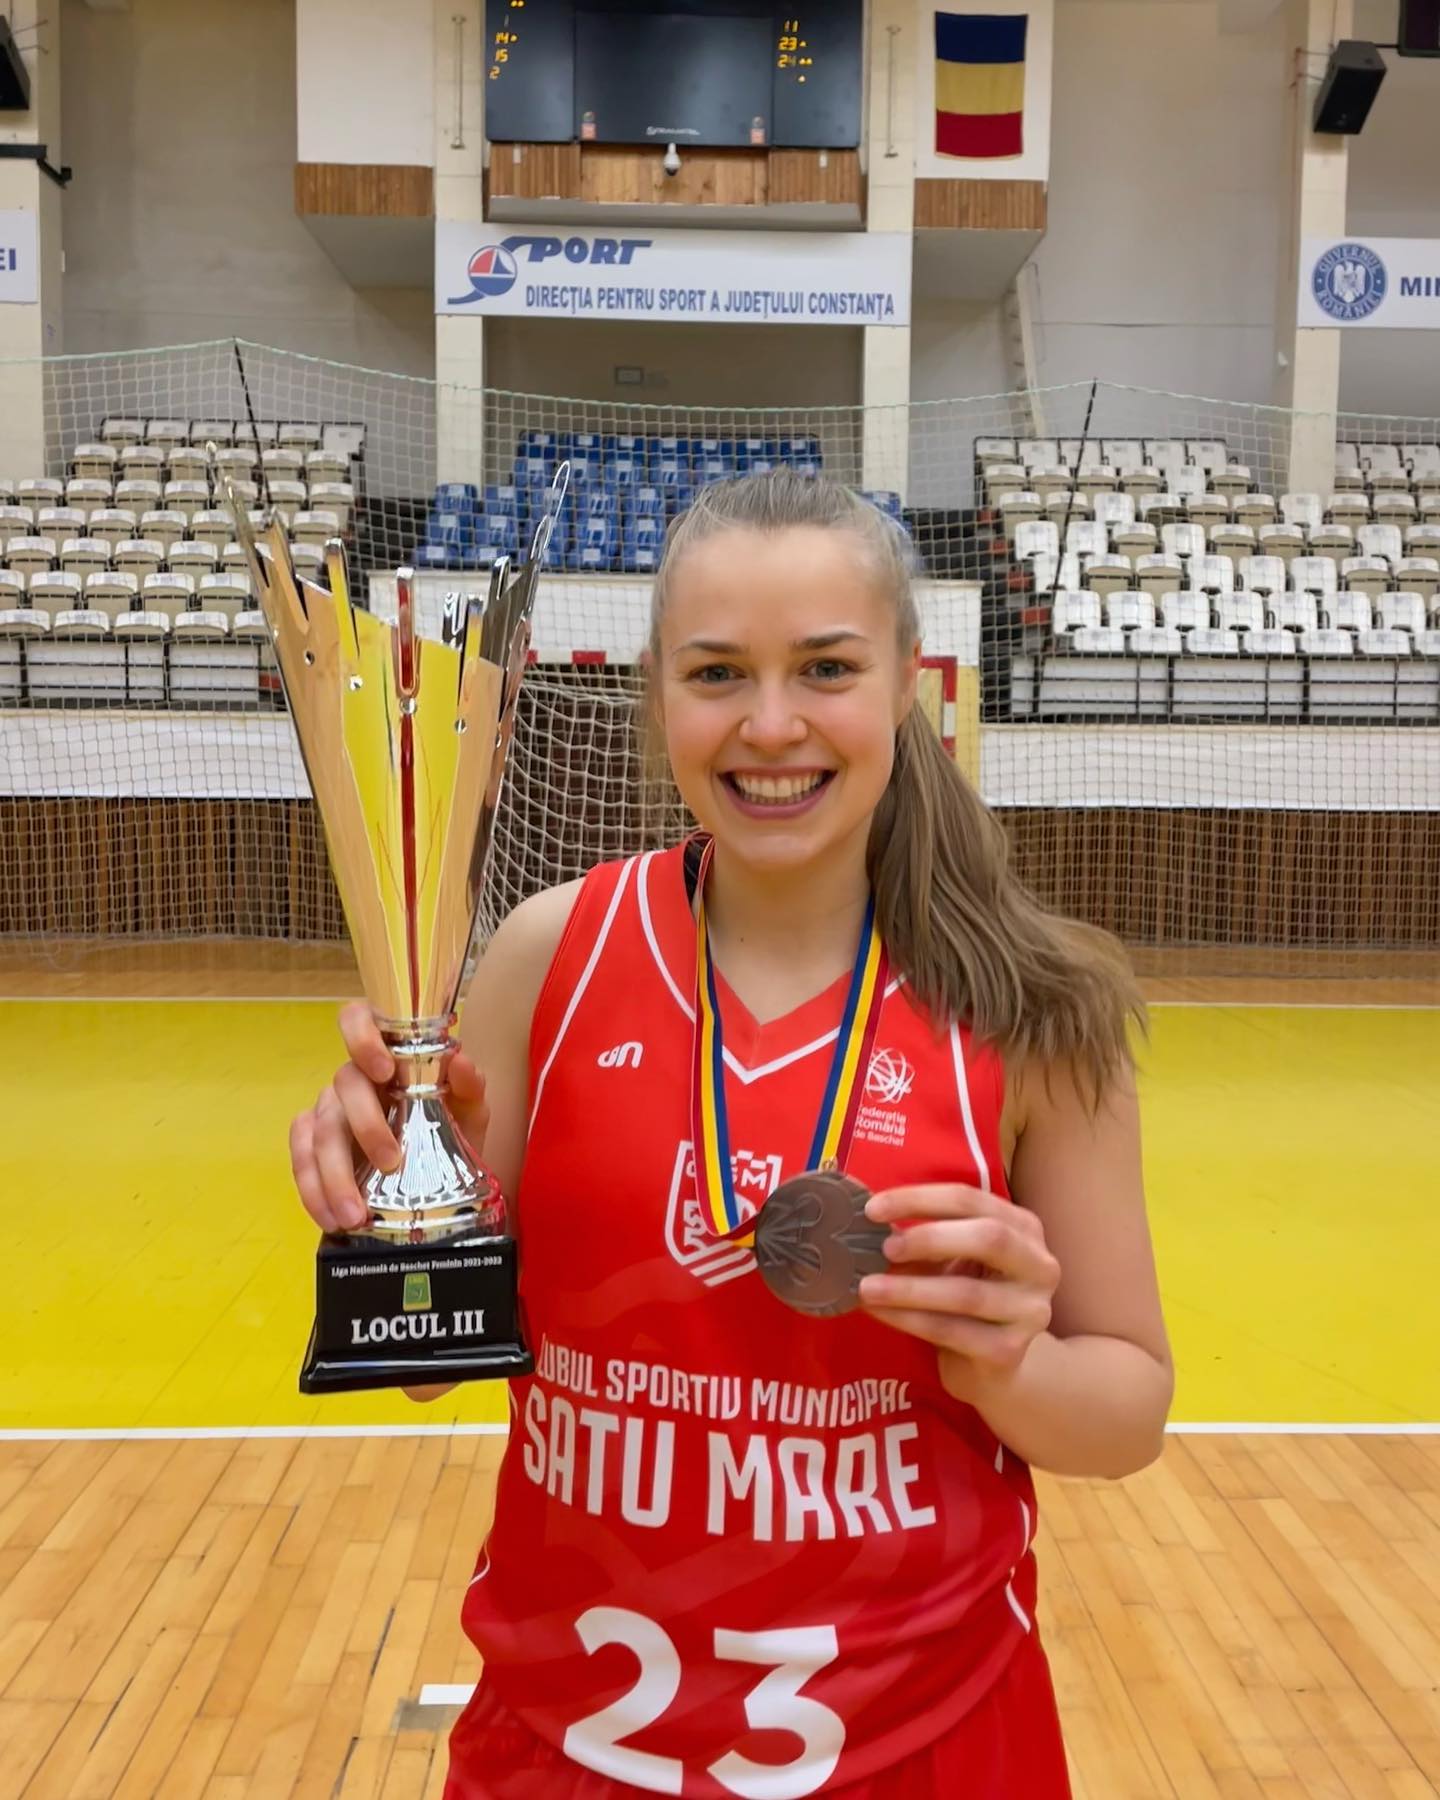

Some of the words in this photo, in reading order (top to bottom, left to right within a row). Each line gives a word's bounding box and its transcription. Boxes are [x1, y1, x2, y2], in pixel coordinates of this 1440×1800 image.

[779, 36, 798, 51] 23
[597, 287, 655, 310] PENTRU
[659, 288, 706, 312] SPORT
[710, 290, 721, 312] A
[331, 1265, 348, 1279] Liga
[388, 1261, 399, 1273] de
[400, 1260, 430, 1273] Baschet
[431, 1258, 463, 1271] Feminin
[351, 1311, 447, 1344] LOCUL
[453, 1309, 485, 1337] III
[606, 1359, 742, 1420] SPORTIV
[751, 1378, 913, 1428] MUNICIPAL
[523, 1384, 676, 1528] SATU
[706, 1421, 937, 1543] MARE
[563, 1606, 847, 1800] 23
